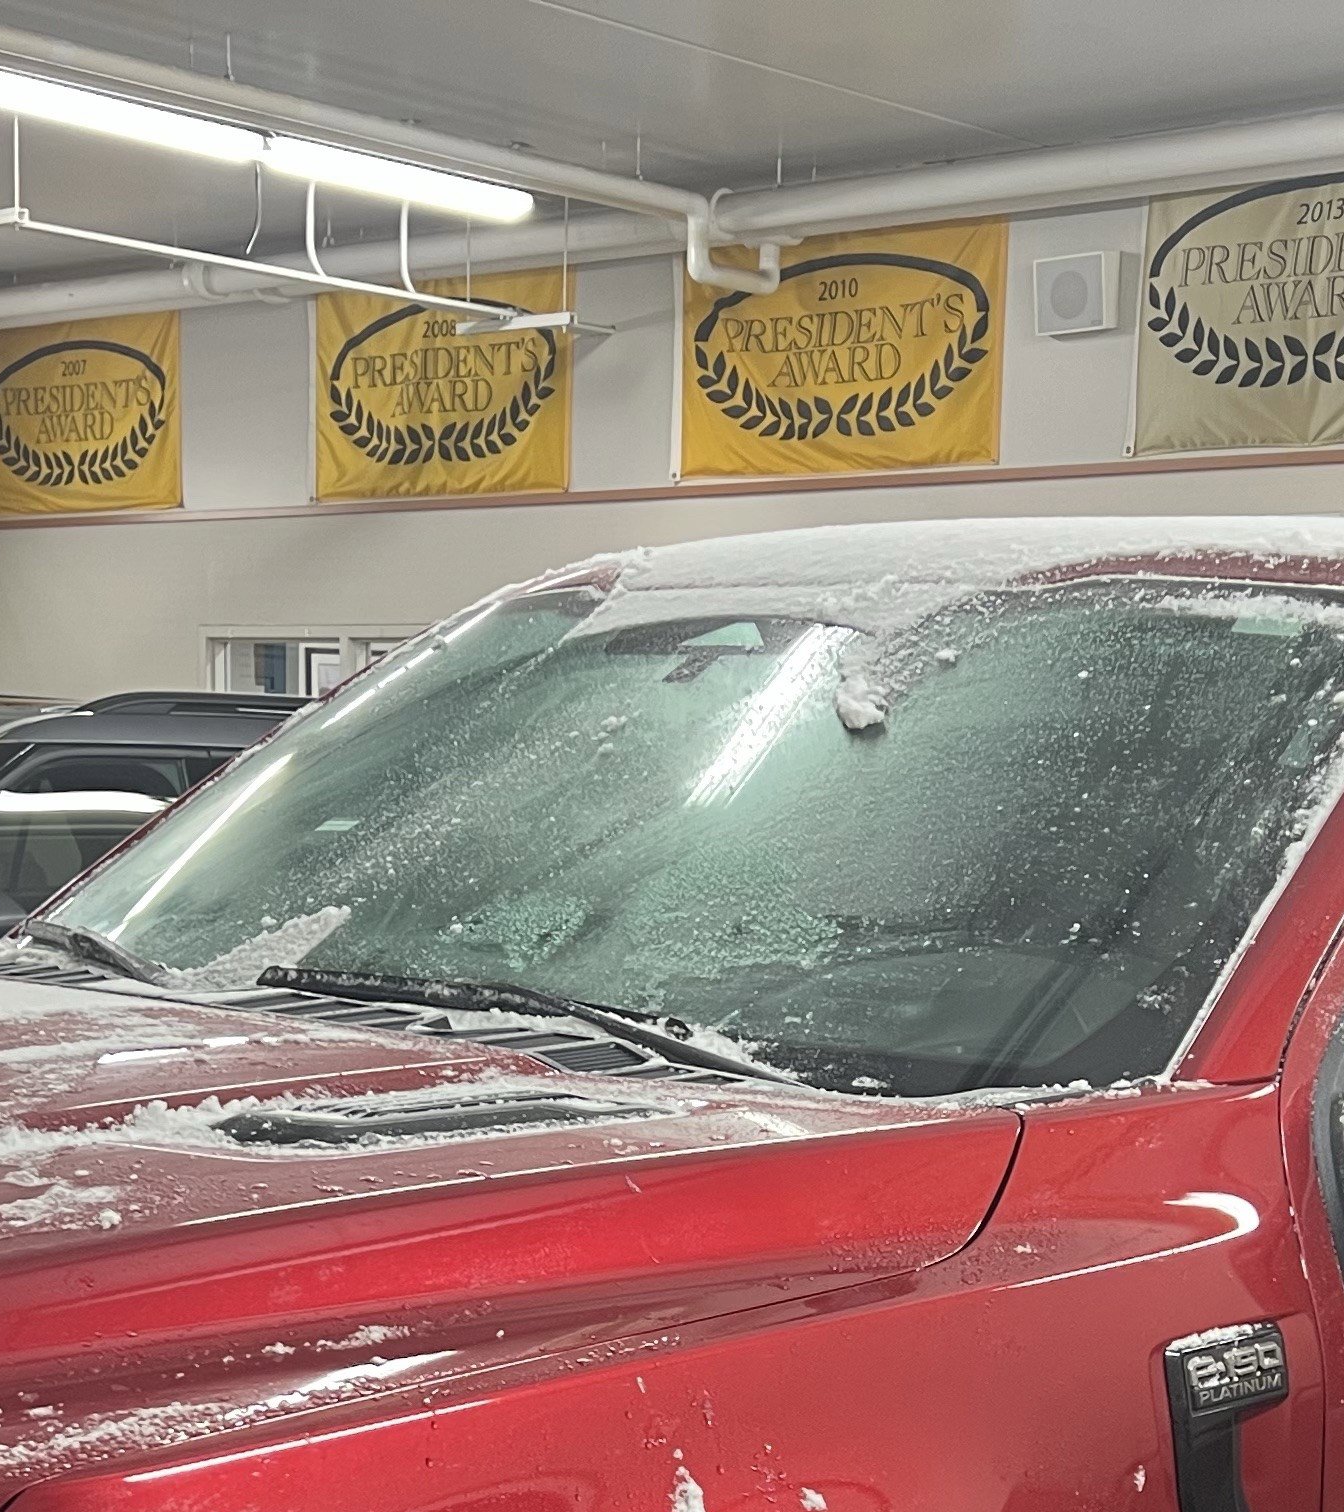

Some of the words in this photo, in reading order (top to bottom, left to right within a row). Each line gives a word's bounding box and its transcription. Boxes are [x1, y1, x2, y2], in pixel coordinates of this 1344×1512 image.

[817, 277, 859, 302] 2010
[421, 319, 457, 339] 2008
[720, 292, 965, 354] PRESIDENT'S
[60, 359, 88, 378] 2007
[350, 336, 539, 390] PRESIDENT'S
[766, 341, 902, 389] AWARD
[389, 377, 493, 418] AWARD
[35, 410, 115, 445] AWARD
[1198, 1372, 1283, 1407] PLATINUM
